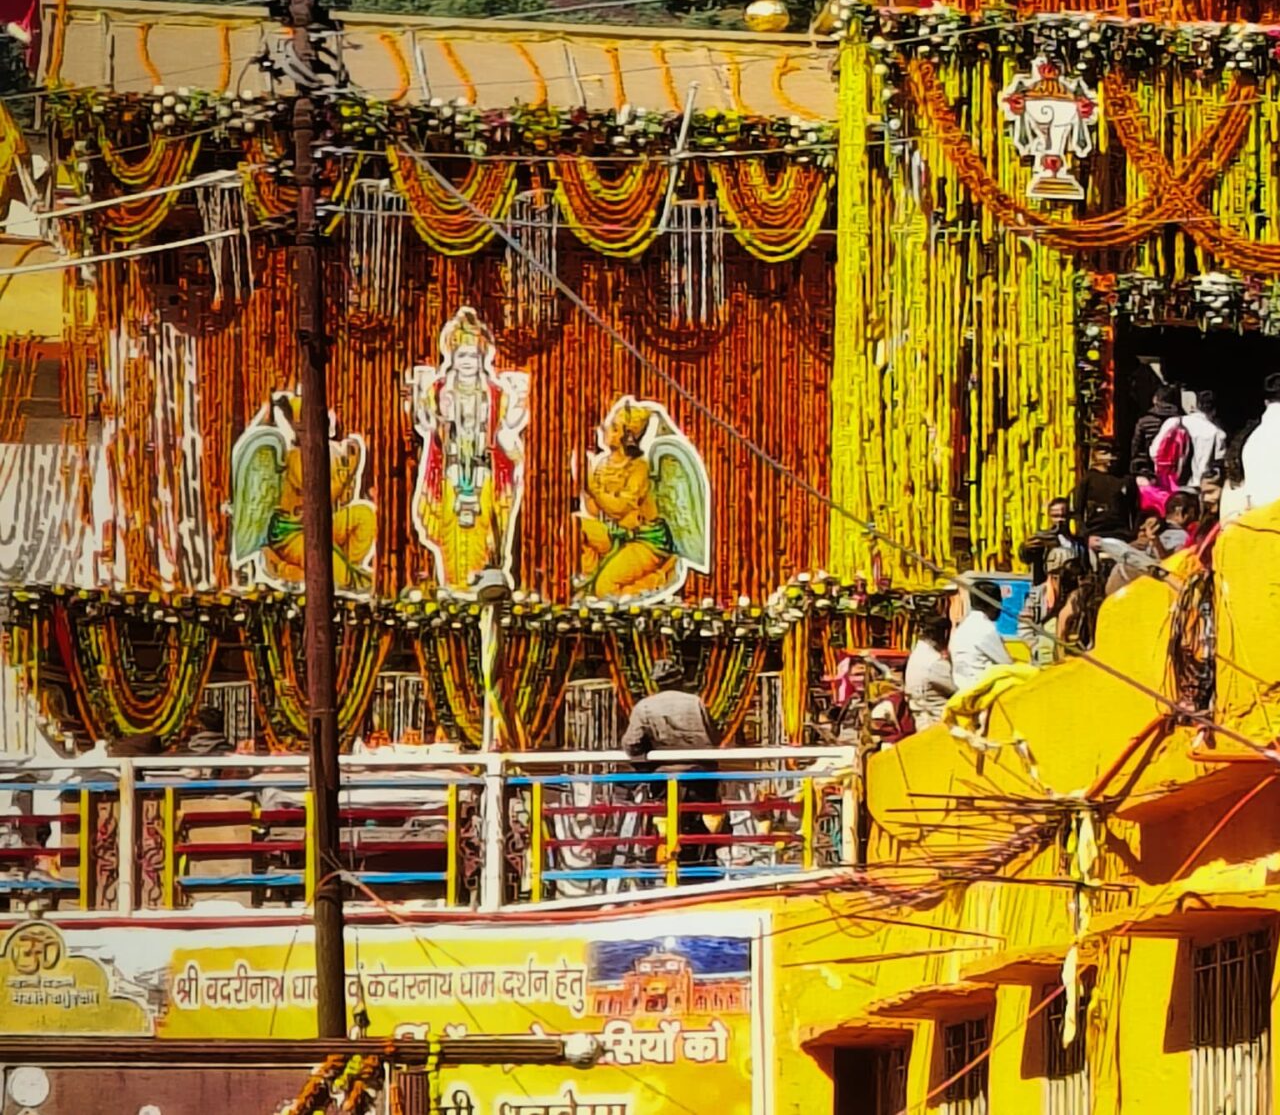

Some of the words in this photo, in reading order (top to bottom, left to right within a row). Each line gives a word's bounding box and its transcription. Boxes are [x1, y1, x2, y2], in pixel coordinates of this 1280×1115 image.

[176, 964, 199, 1004] श्री
[502, 958, 549, 998] दर्शन
[555, 958, 584, 1012] हेतु
[683, 1017, 730, 1063] को
